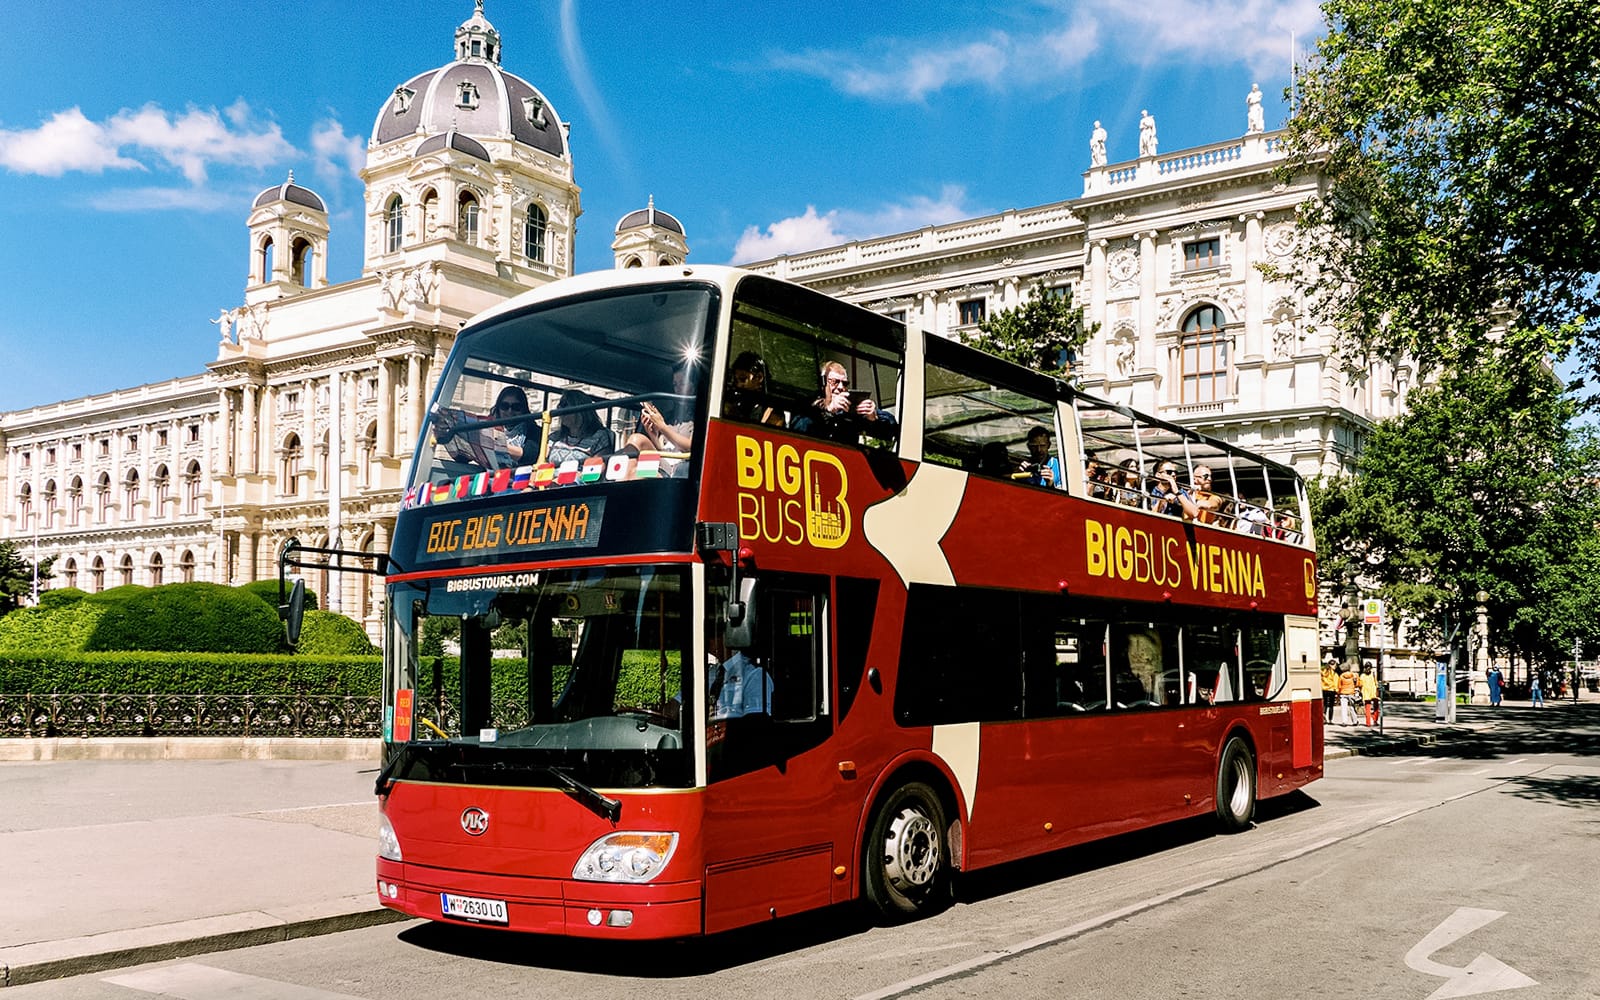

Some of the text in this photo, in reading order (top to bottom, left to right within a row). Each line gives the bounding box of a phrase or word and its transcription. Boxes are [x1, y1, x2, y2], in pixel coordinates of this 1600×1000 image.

[736, 434, 802, 495] BIG
[426, 503, 590, 553] BIG BUS VIENNA
[738, 492, 804, 545] BUS
[447, 573, 539, 592] BIGBUSTOURS.COM
[1186, 540, 1266, 599] VIENNA
[462, 899, 488, 916] 2630
